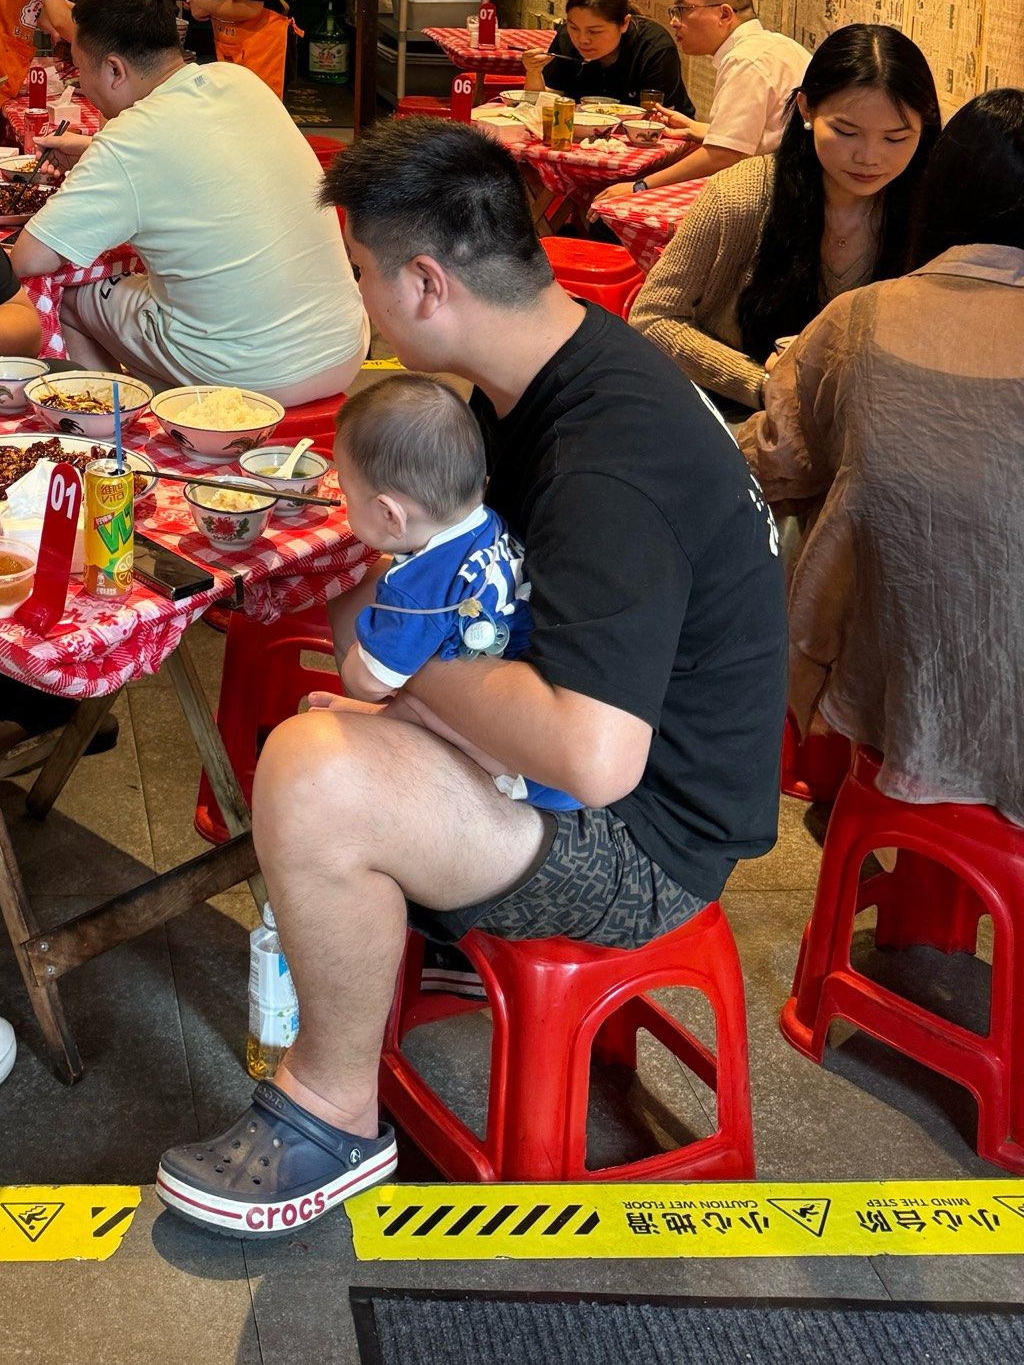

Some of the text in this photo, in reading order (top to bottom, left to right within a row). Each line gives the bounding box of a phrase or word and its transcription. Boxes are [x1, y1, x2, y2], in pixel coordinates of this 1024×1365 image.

[480, 9, 494, 20] 07
[30, 69, 45, 85] 03
[454, 79, 472, 94] 06
[51, 474, 77, 519] 01
[245, 1191, 326, 1230] crocs
[622, 1200, 758, 1209] CAUTION WET FLOOR
[866, 1198, 971, 1207] MIND THE STEP
[626, 1211, 769, 1235] 小心地滑
[856, 1209, 1000, 1233] 小心台阶
